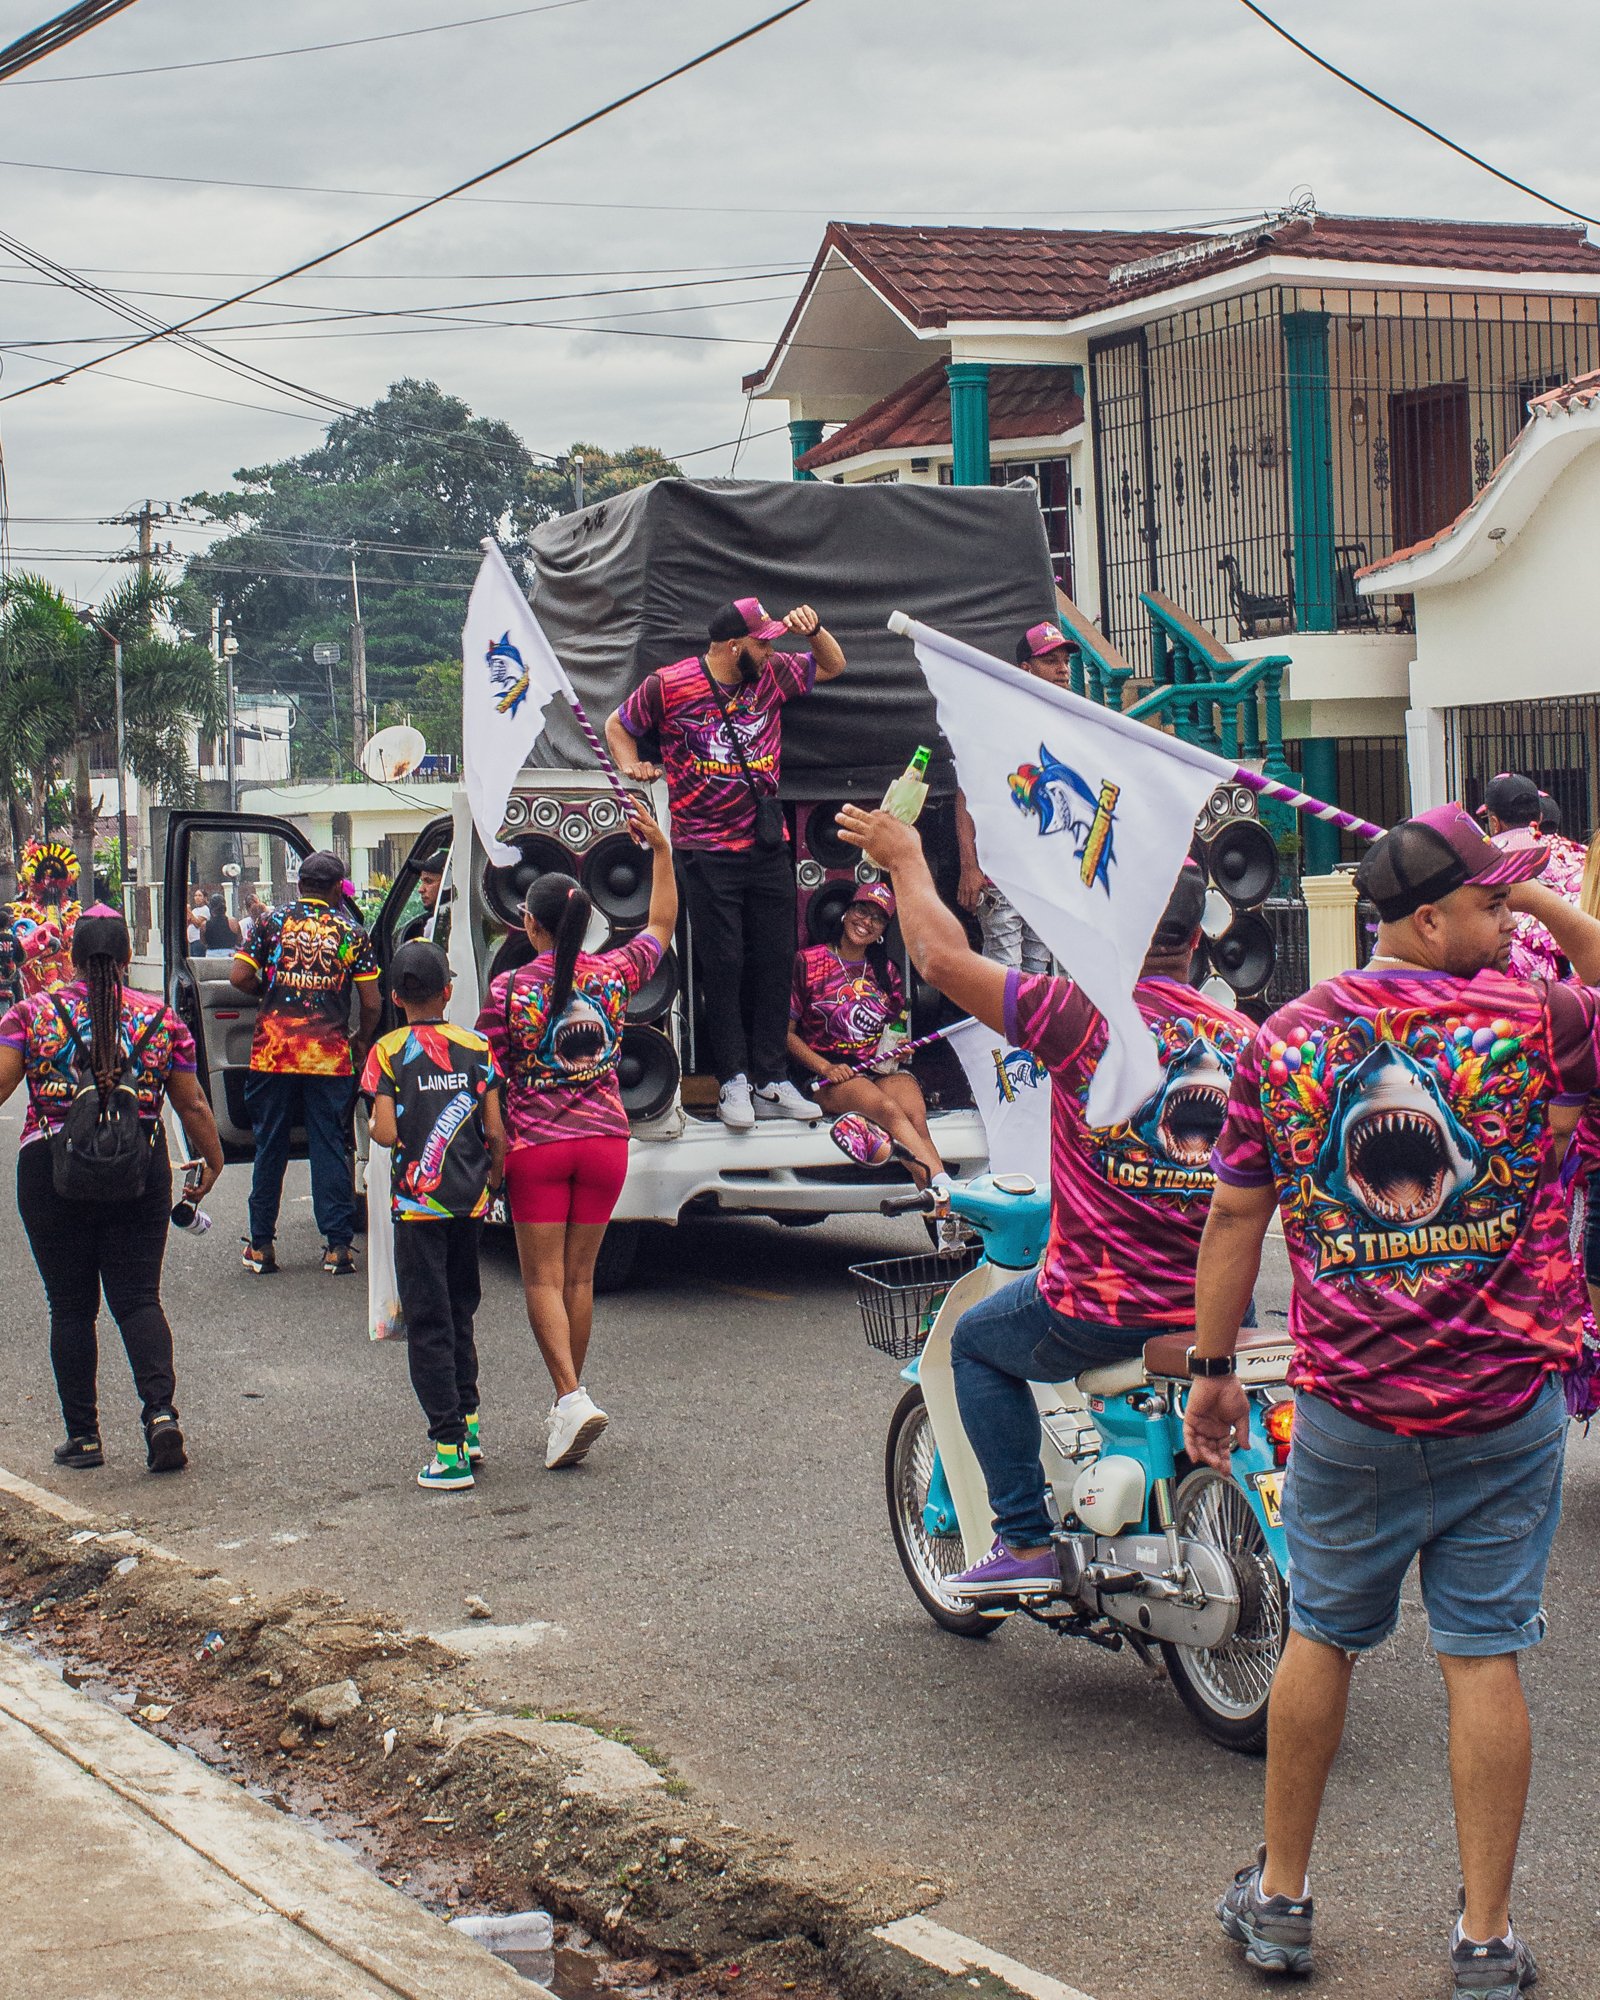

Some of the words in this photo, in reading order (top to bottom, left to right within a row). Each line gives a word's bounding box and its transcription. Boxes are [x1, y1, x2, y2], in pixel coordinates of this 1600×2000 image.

[38, 1080, 67, 1097] LOS
[417, 1073, 469, 1091] LAINER
[1106, 1156, 1149, 1188] LOS
[1358, 1207, 1517, 1263] TIBURONES
